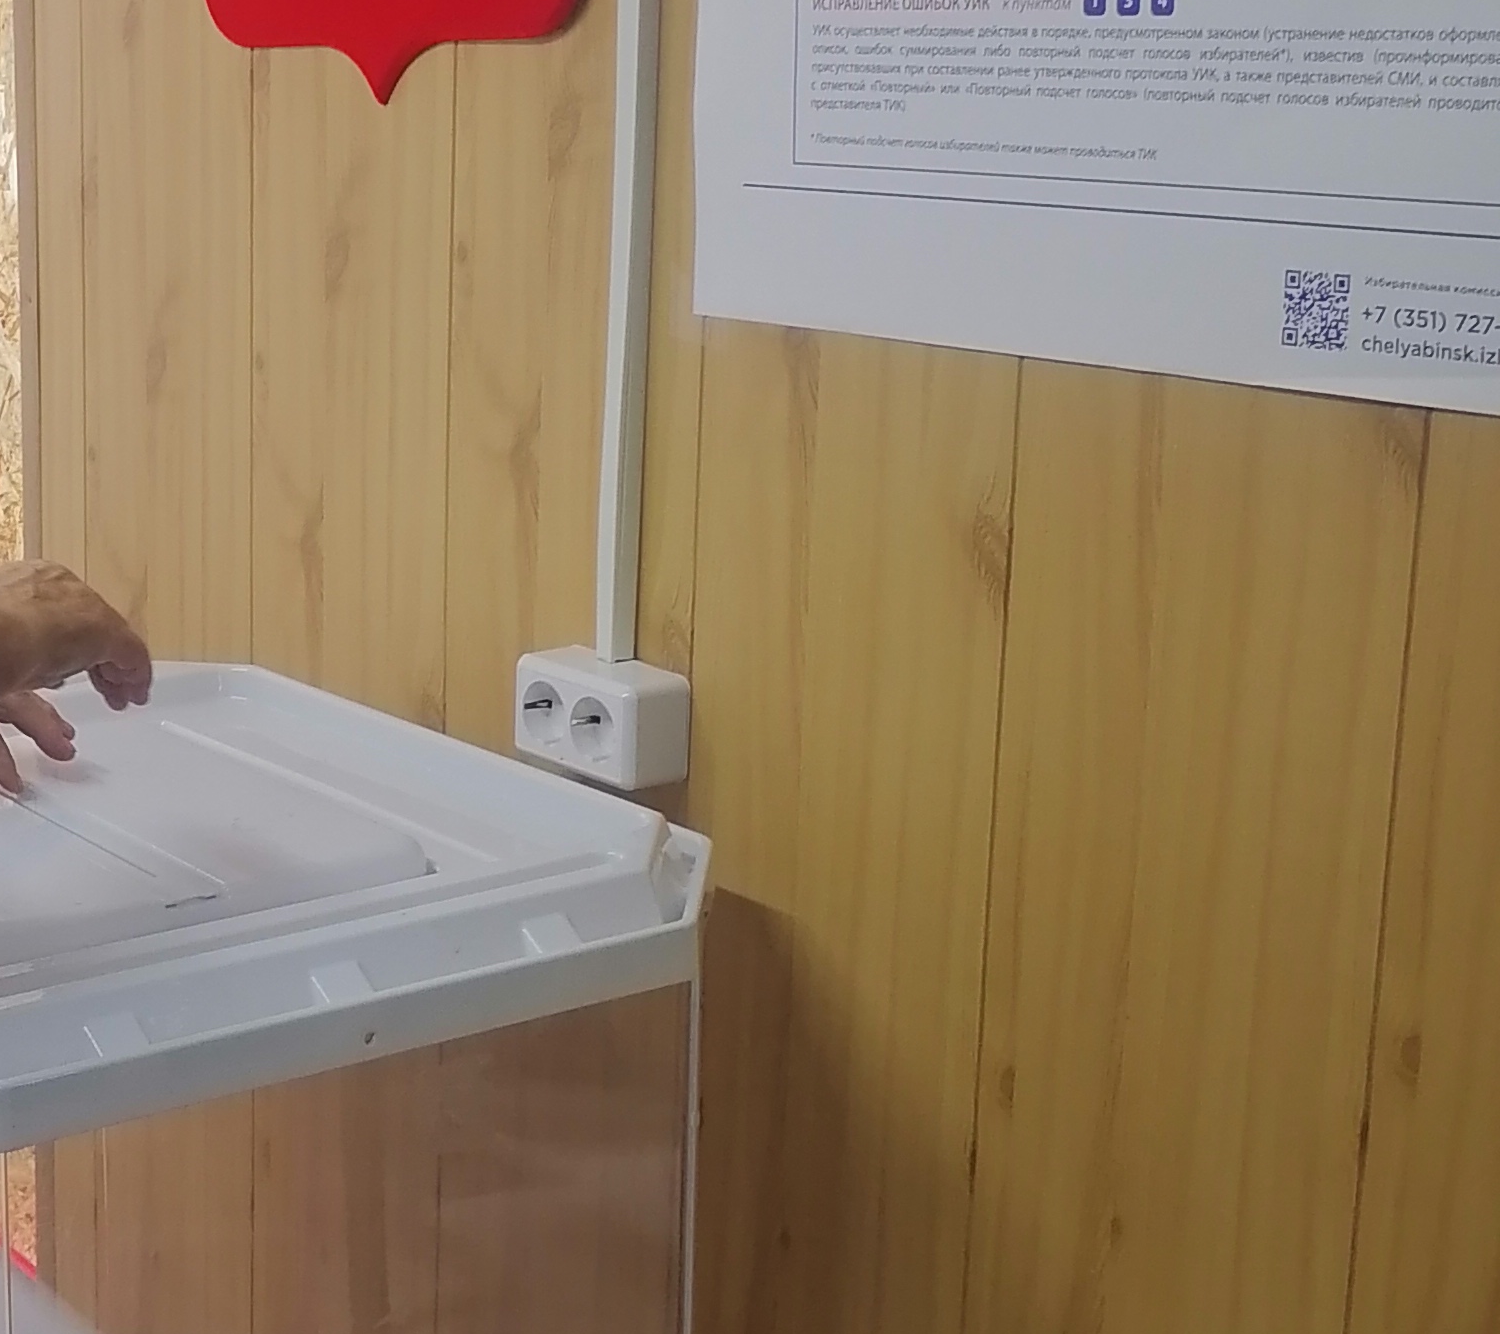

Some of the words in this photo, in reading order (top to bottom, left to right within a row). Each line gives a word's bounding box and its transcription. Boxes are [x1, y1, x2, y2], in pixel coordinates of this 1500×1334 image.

[1002, 0, 1010, 9] к
[1012, 0, 1071, 13] пунктам
[1361, 306, 1386, 324] +7
[1393, 307, 1447, 333] (351)
